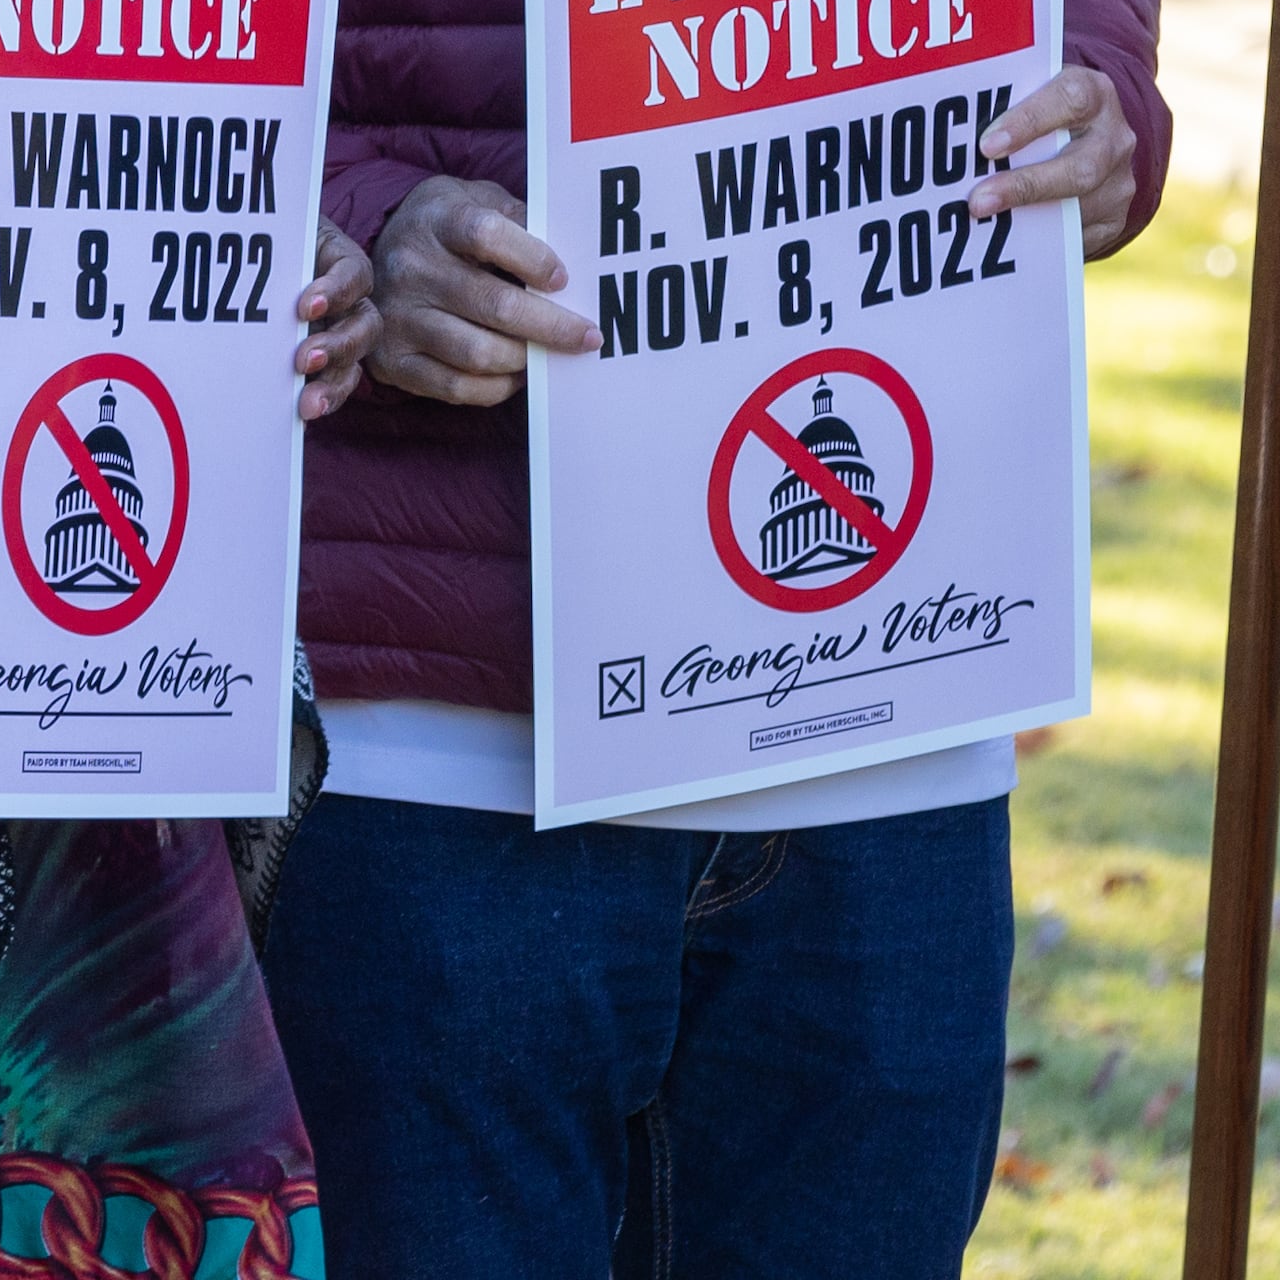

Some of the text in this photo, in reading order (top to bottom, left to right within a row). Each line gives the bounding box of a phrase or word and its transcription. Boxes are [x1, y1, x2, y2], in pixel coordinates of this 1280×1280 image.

[11, 111, 279, 215] WARNOCK
[600, 84, 1013, 257] R. WARNOCK
[75, 229, 125, 337] 8,
[148, 230, 272, 323] 2022
[599, 200, 1016, 359] NOV. 8, 2022
[137, 639, 253, 709] Voters
[660, 583, 1035, 708] Georgia Voters
[27, 758, 44, 767] PAID
[45, 758, 59, 767] FOR
[60, 758, 69, 767] BY
[70, 758, 87, 767] TEAM
[755, 733, 774, 745] PAID
[775, 730, 792, 740] FOR
[793, 728, 803, 737] BY
[804, 723, 825, 734] TEAM
